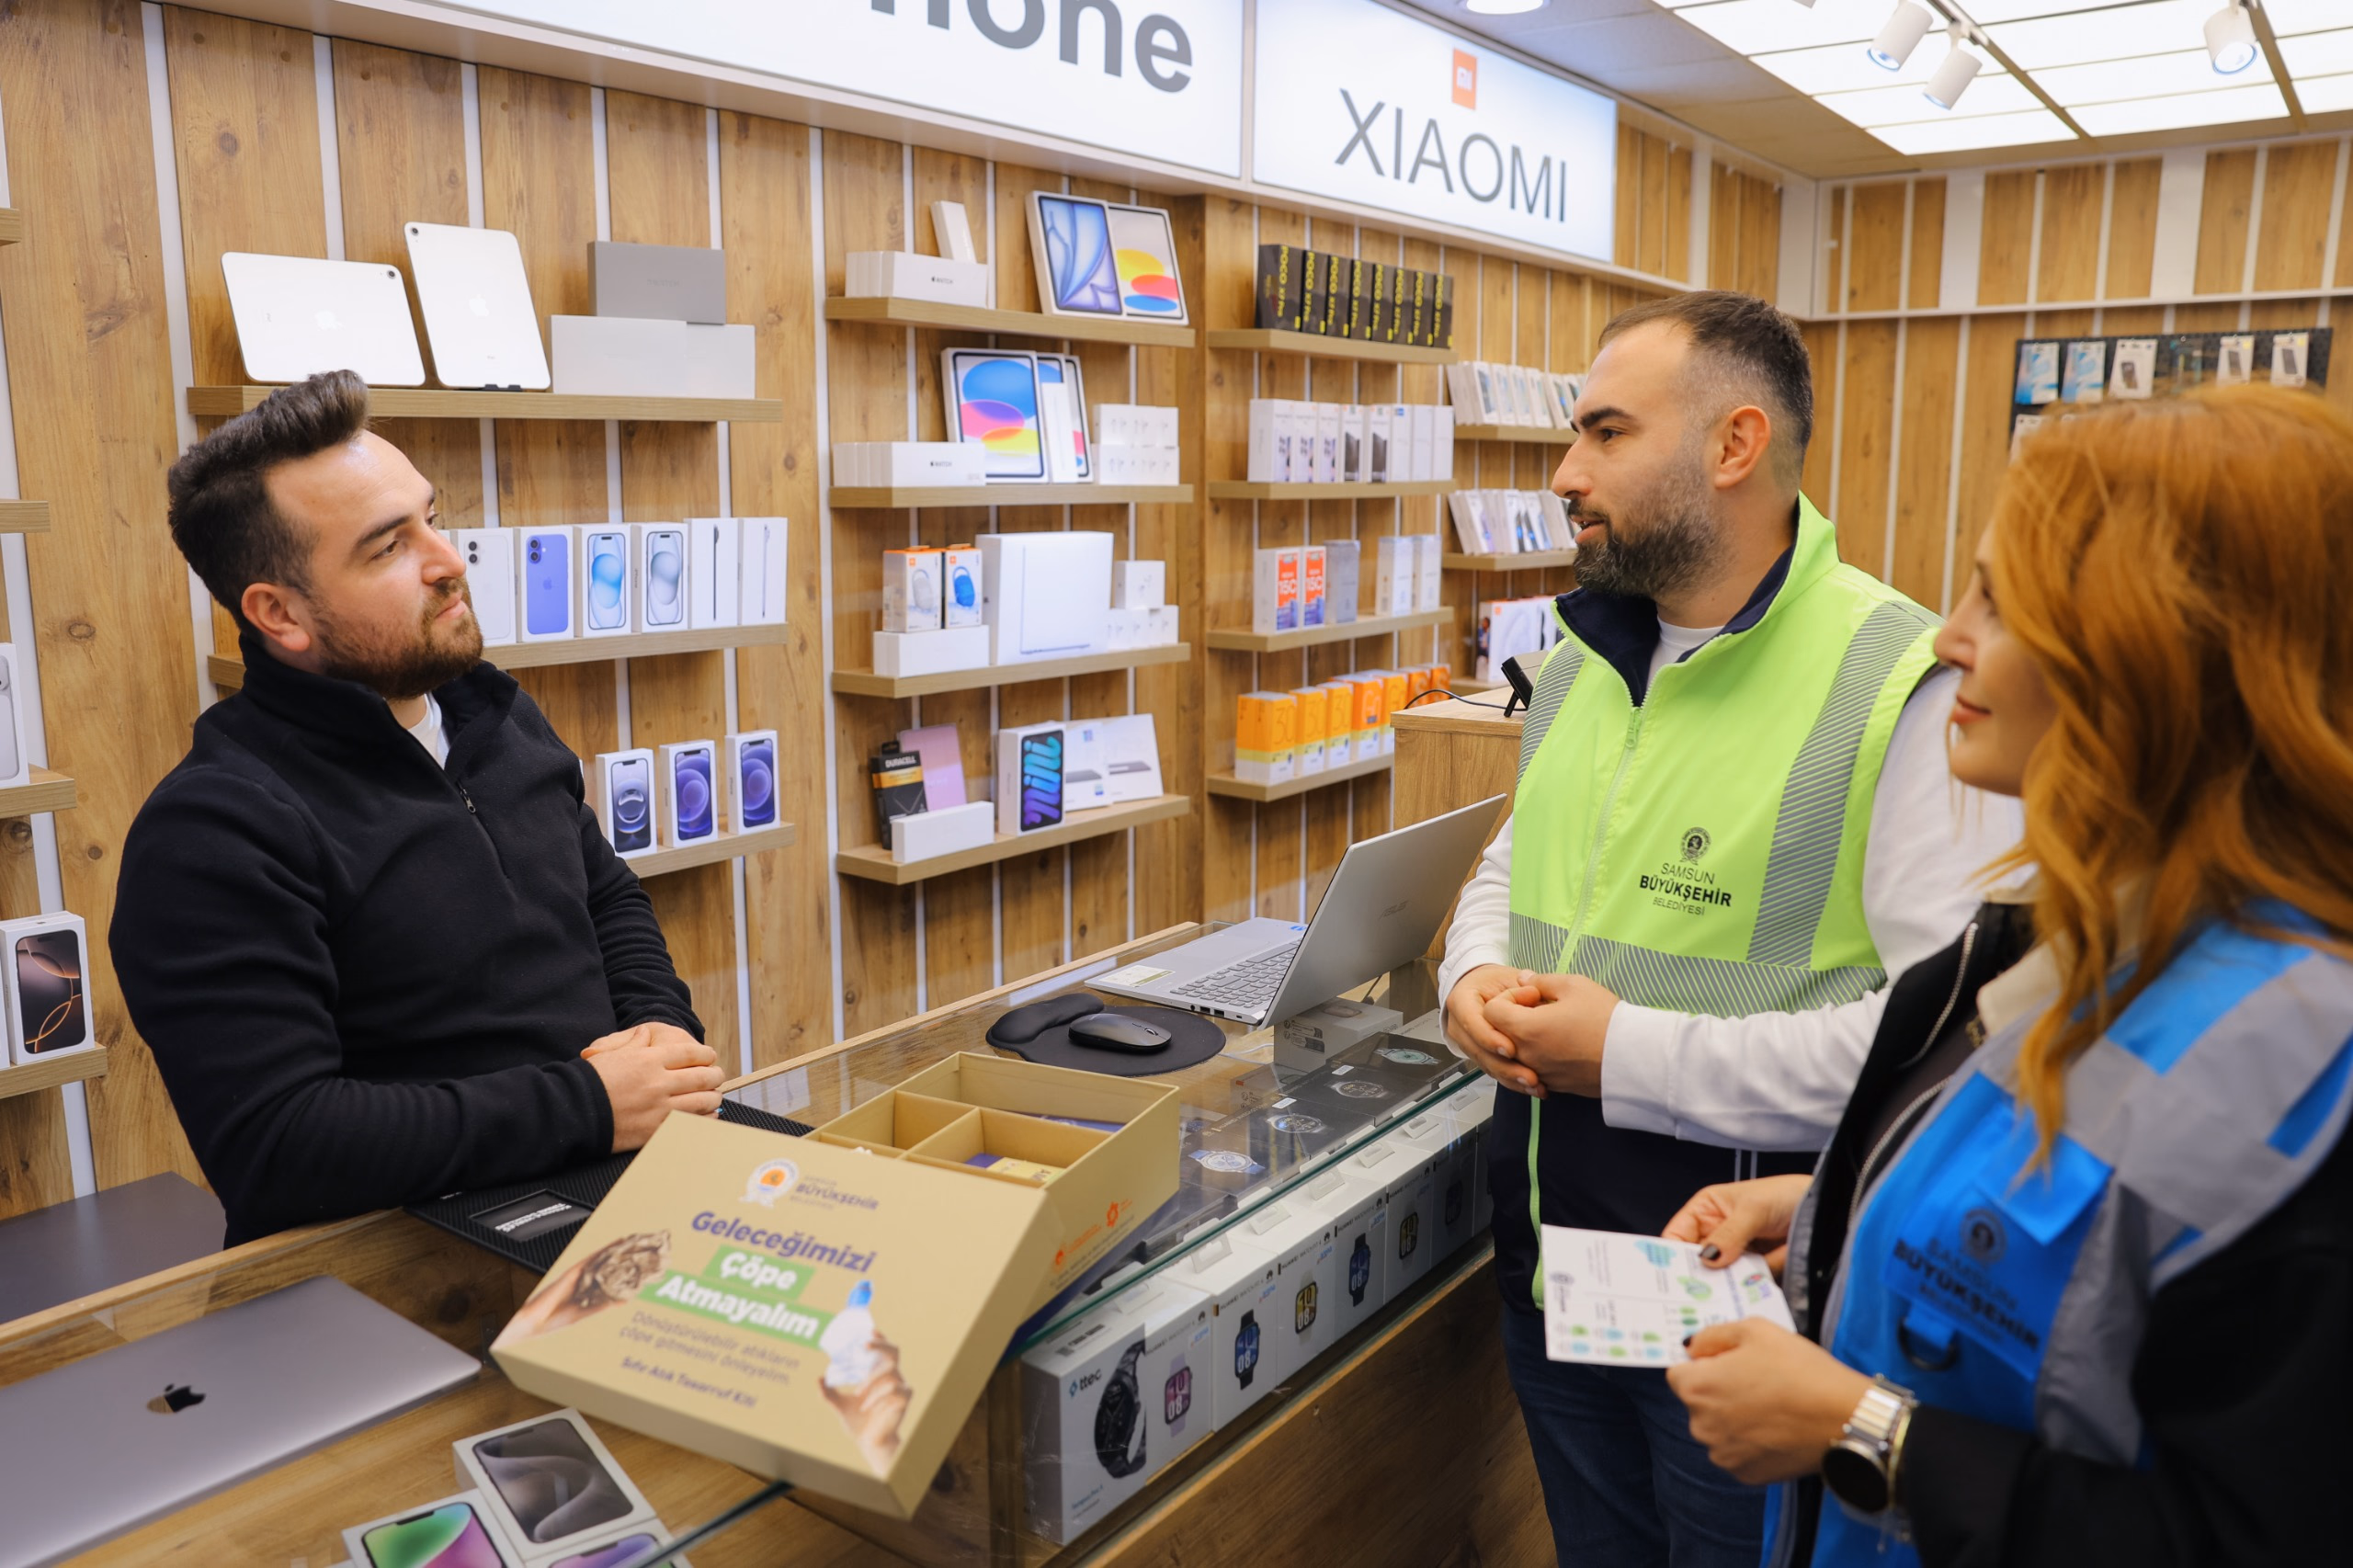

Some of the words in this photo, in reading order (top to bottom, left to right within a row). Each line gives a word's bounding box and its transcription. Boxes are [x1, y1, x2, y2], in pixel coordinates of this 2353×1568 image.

[1335, 87, 1566, 222] XIAOMI
[1279, 245, 1289, 285] POCO
[1306, 252, 1314, 290] POCO
[1330, 256, 1338, 294] POCO
[1353, 260, 1361, 297] POCO
[1374, 265, 1383, 301] POCO
[885, 756, 916, 768] DURACELL
[1640, 874, 1733, 906] BÜYÜKŞEHİR
[1661, 862, 1716, 885] SAMSUN
[1652, 895, 1706, 915] BELEDİYESİ
[692, 1210, 877, 1273] Geleceğimizi
[721, 1251, 798, 1290] Çöpe
[655, 1275, 820, 1340] Atmayalım
[1298, 1307, 1310, 1330] 08
[1237, 1349, 1251, 1373] 08
[1079, 1369, 1102, 1391] ttec
[1167, 1395, 1183, 1421] 08
